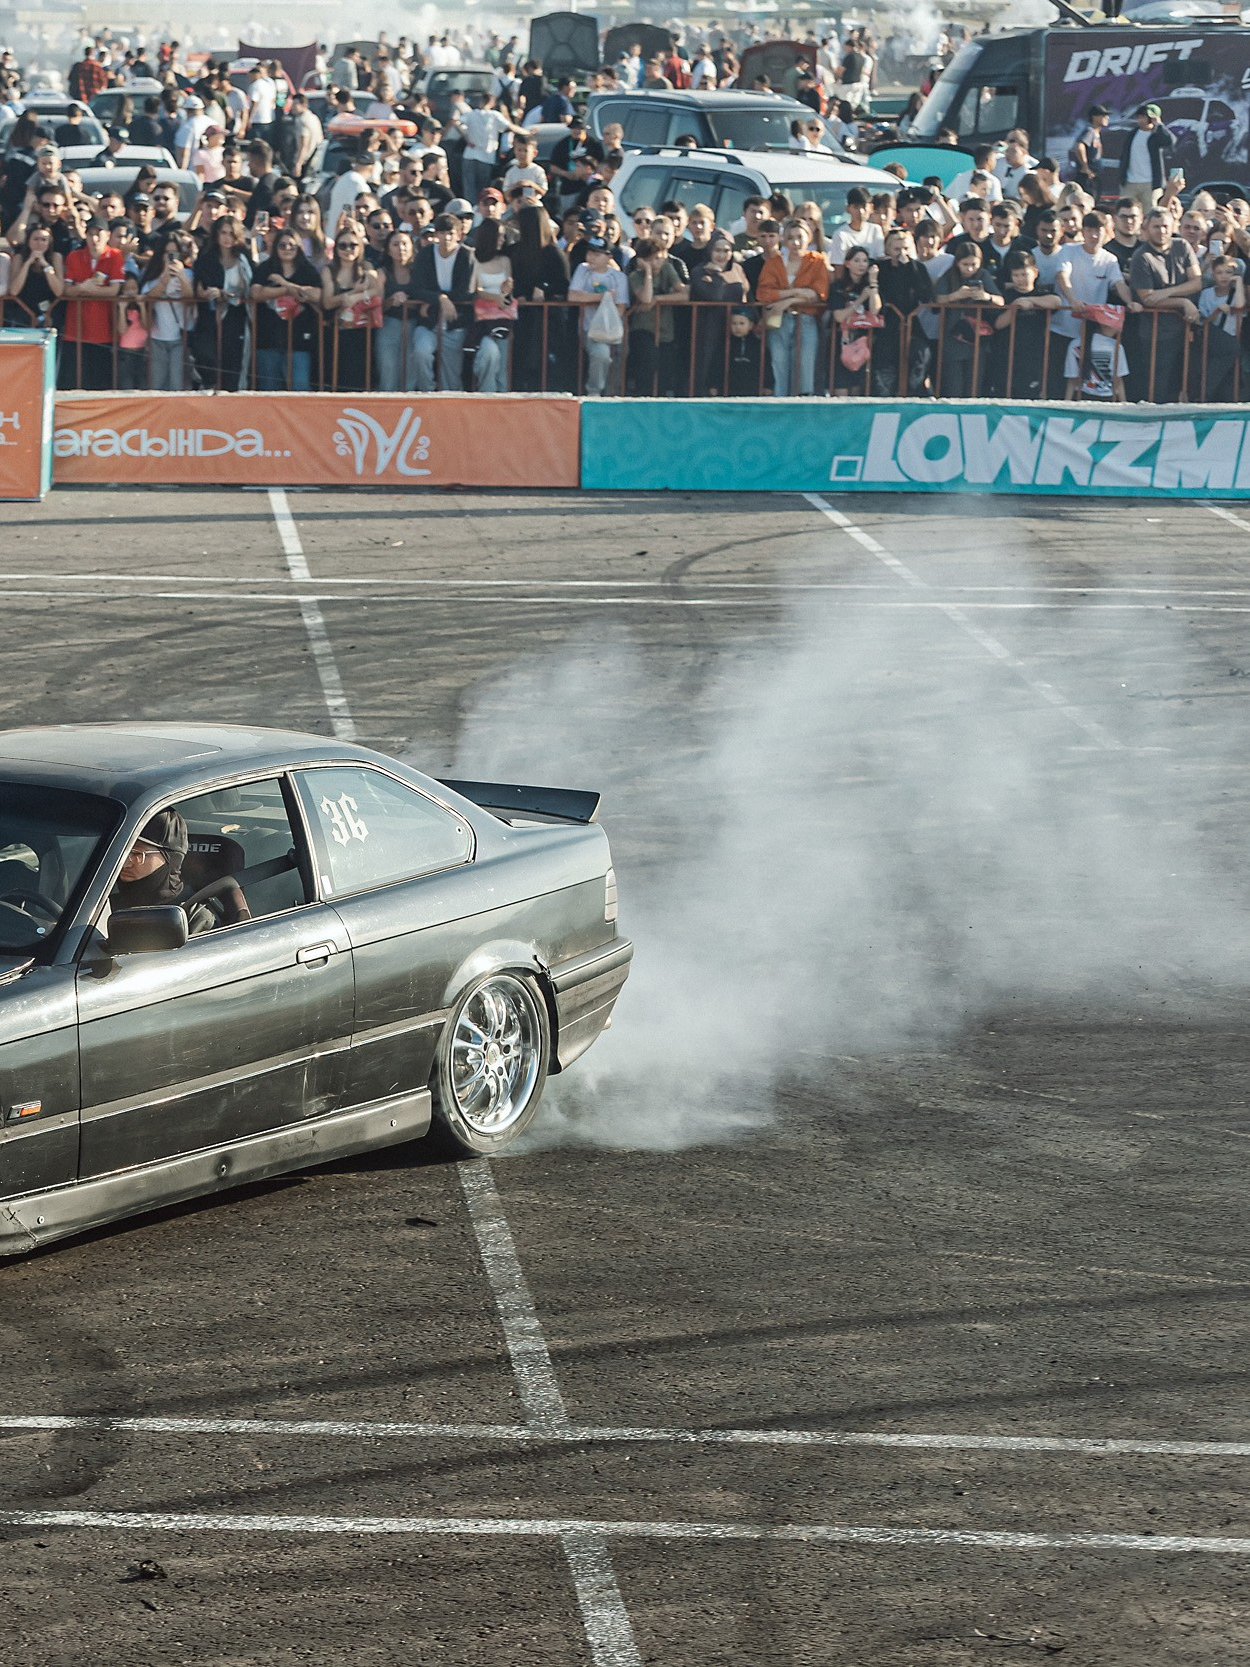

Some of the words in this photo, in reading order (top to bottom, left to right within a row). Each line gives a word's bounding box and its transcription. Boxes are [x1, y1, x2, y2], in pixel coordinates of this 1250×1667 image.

[1063, 39, 1204, 83] DRIFT
[861, 412, 1250, 490] LOWKZM
[320, 792, 369, 848] 36
